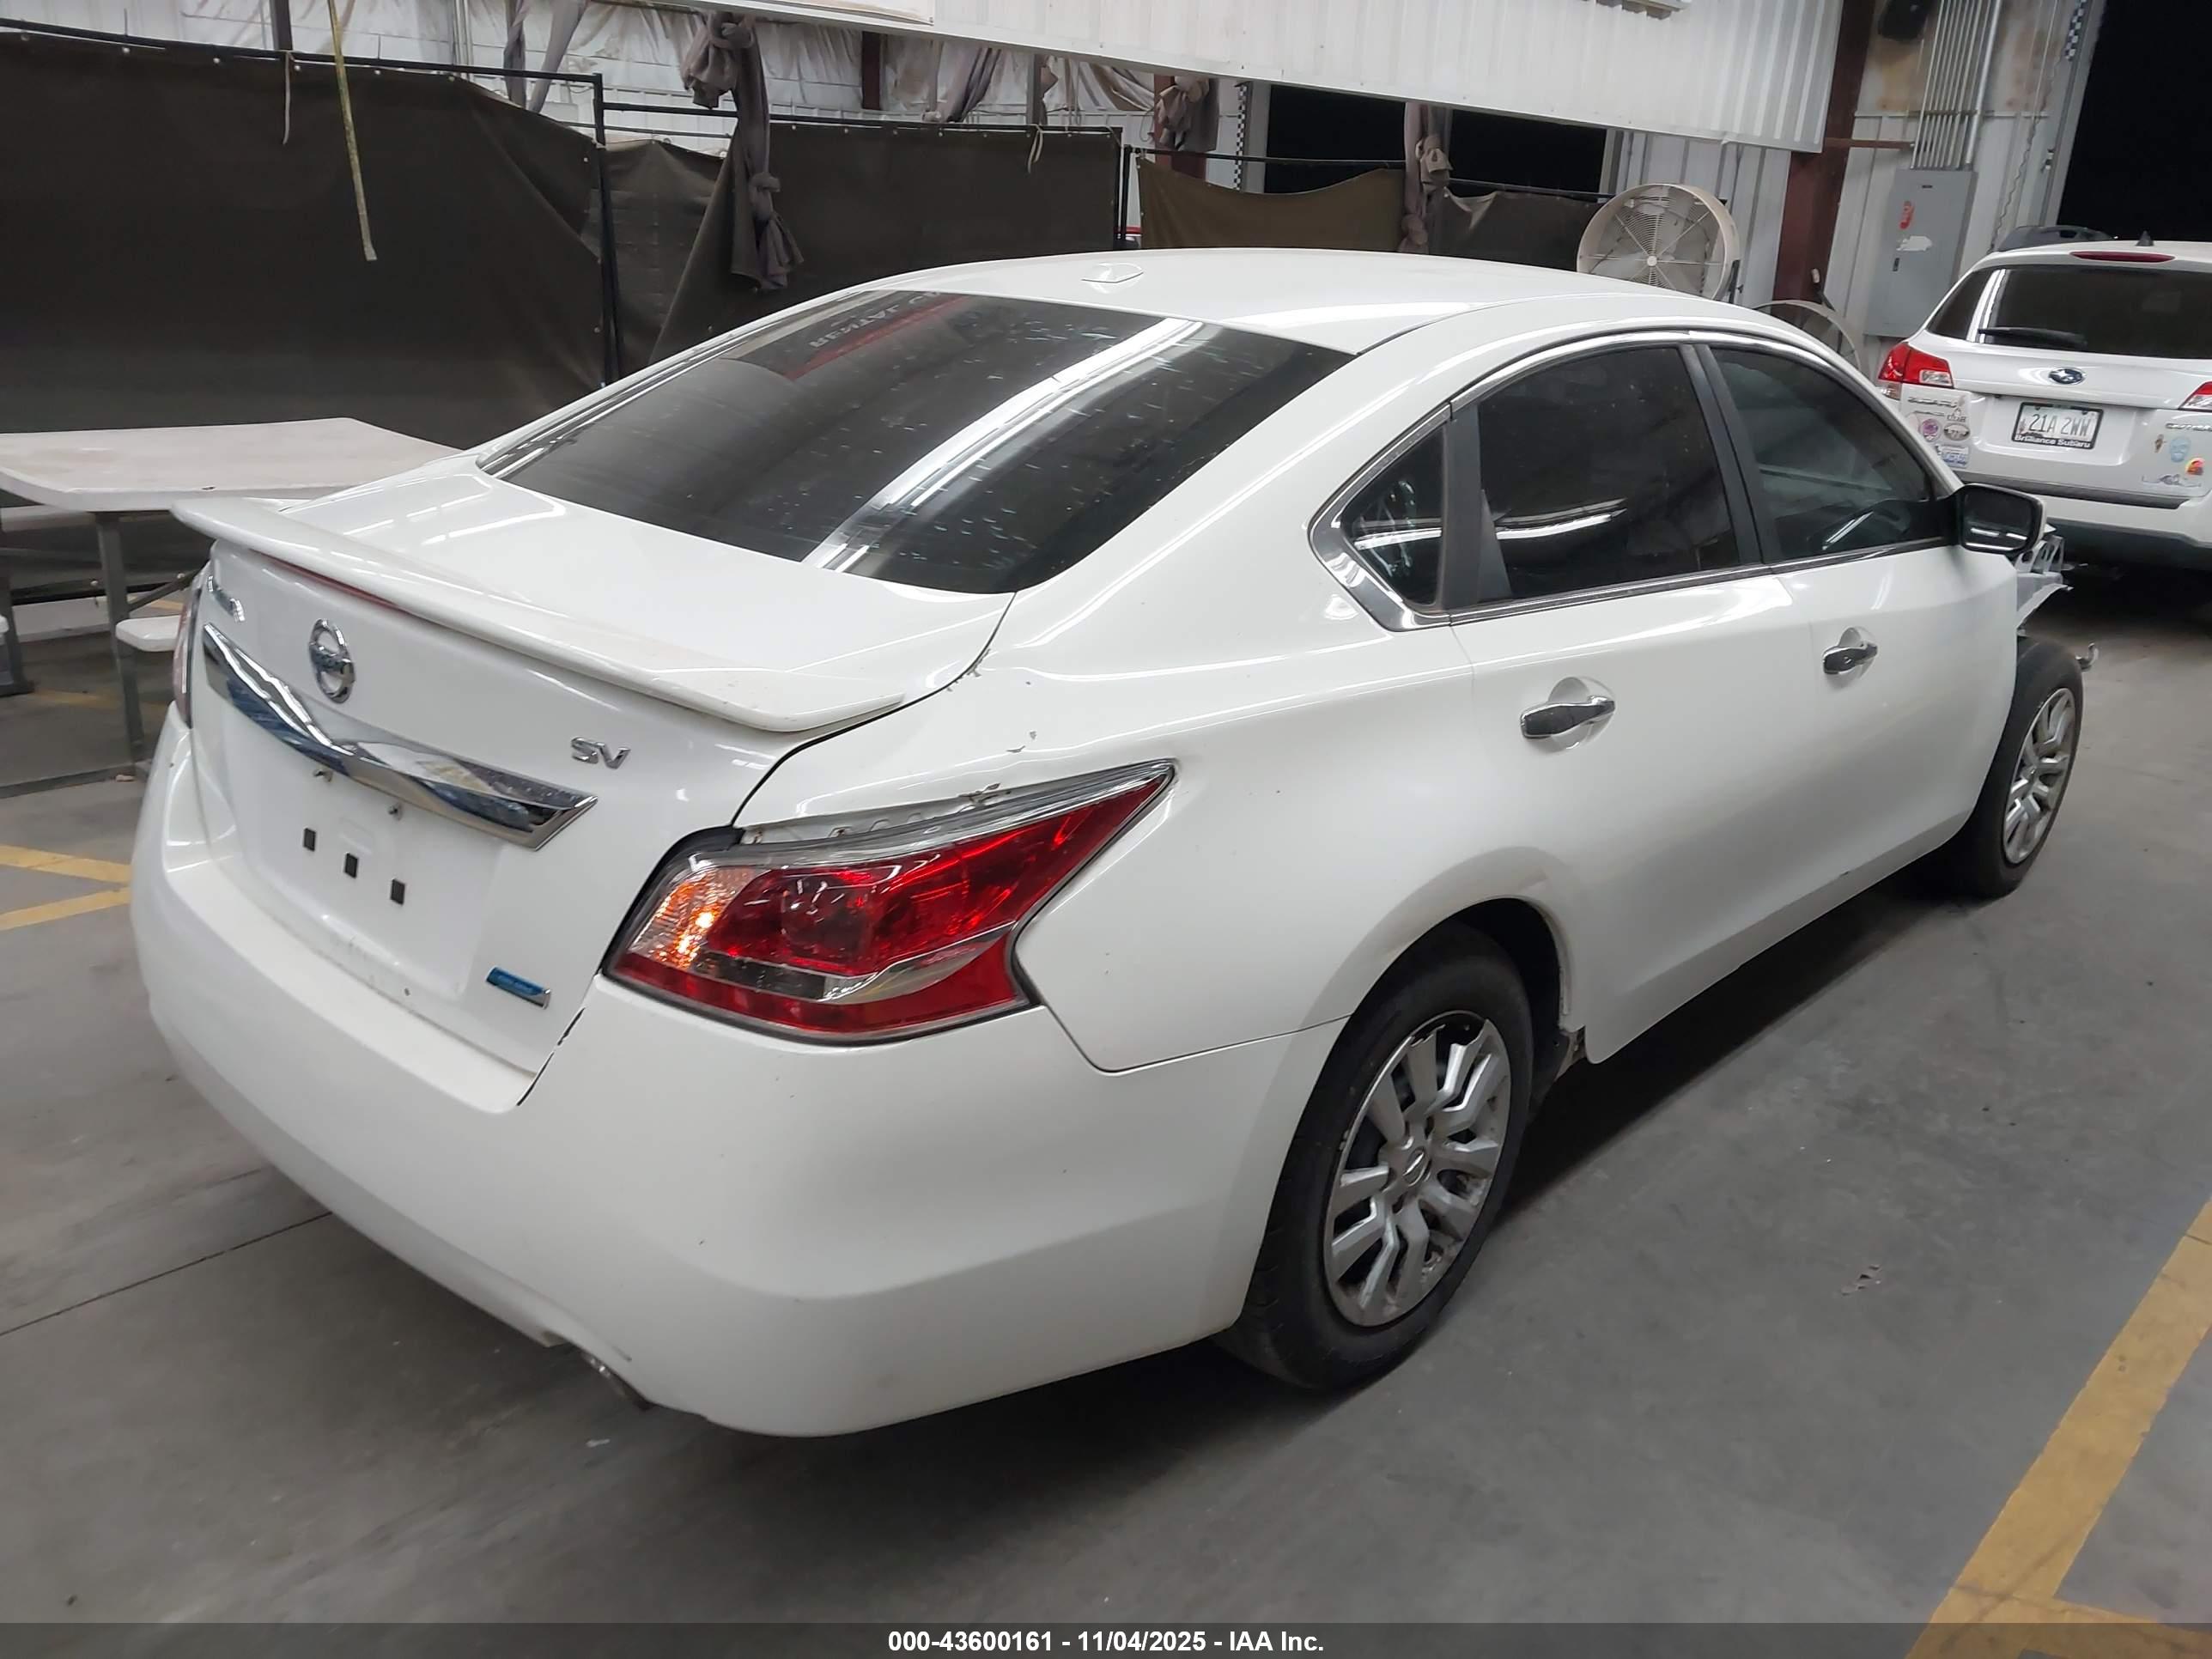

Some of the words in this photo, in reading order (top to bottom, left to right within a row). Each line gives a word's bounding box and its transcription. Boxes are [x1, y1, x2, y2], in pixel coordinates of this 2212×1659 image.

[2029, 413, 2058, 434] 21A
[2057, 439, 2092, 448] Subaru
[571, 736, 631, 770] SV
